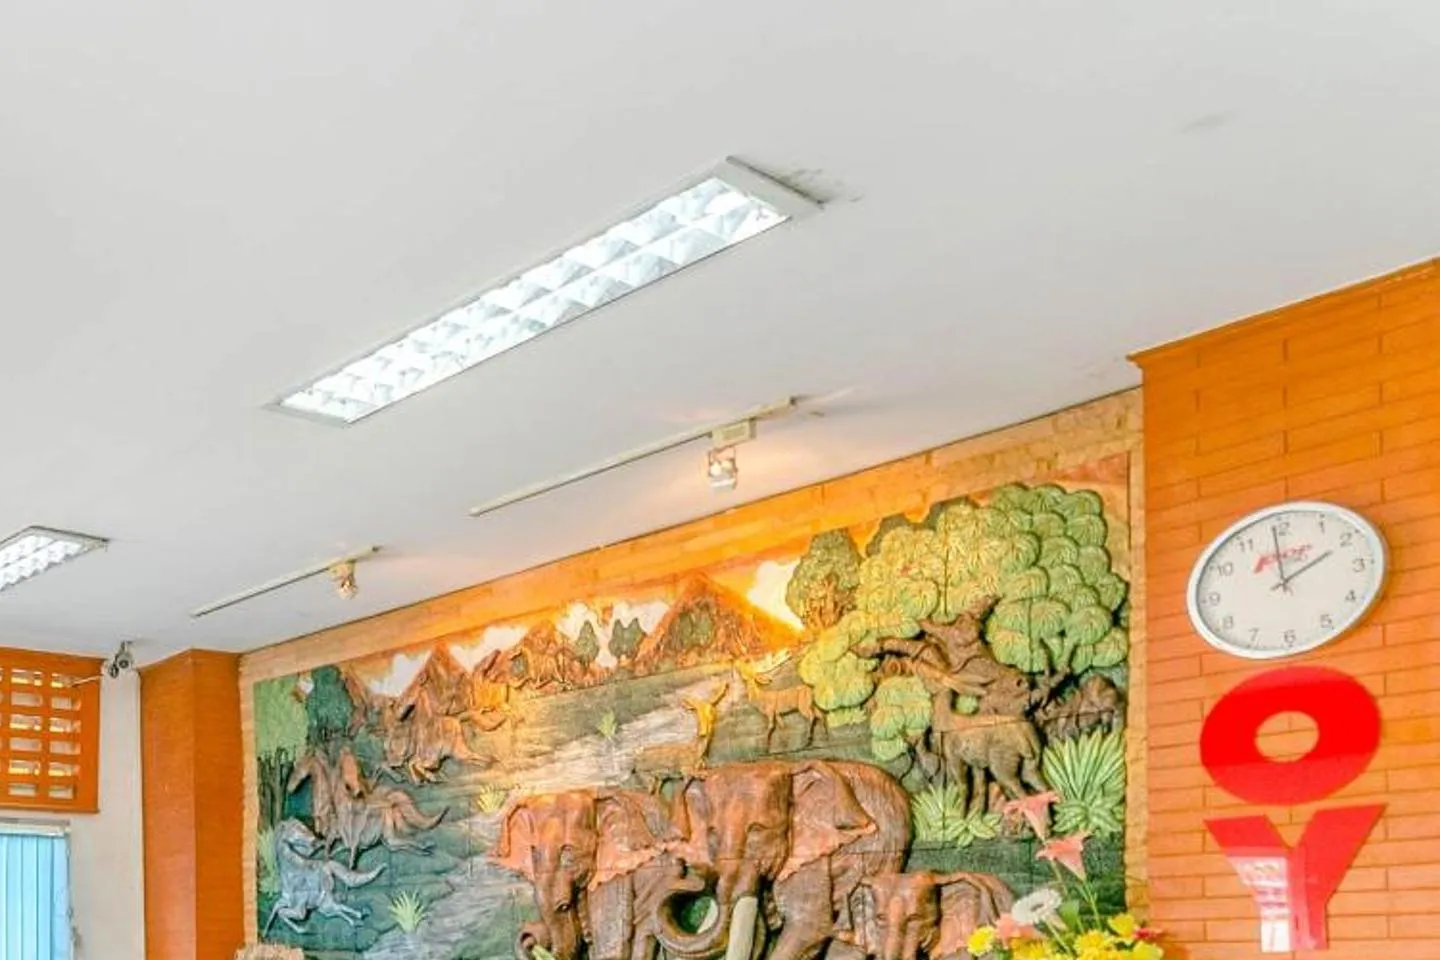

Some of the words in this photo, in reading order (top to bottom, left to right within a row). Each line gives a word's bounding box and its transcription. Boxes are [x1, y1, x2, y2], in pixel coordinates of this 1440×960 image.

[1319, 521, 1326, 534] 1
[1340, 532, 1353, 547] 2
[1353, 558, 1366, 573] 3
[1209, 592, 1221, 606] 9
[1345, 589, 1357, 602] 4
[1320, 614, 1333, 629] 5
[1249, 628, 1260, 642] 7
[1284, 630, 1297, 645] 6
